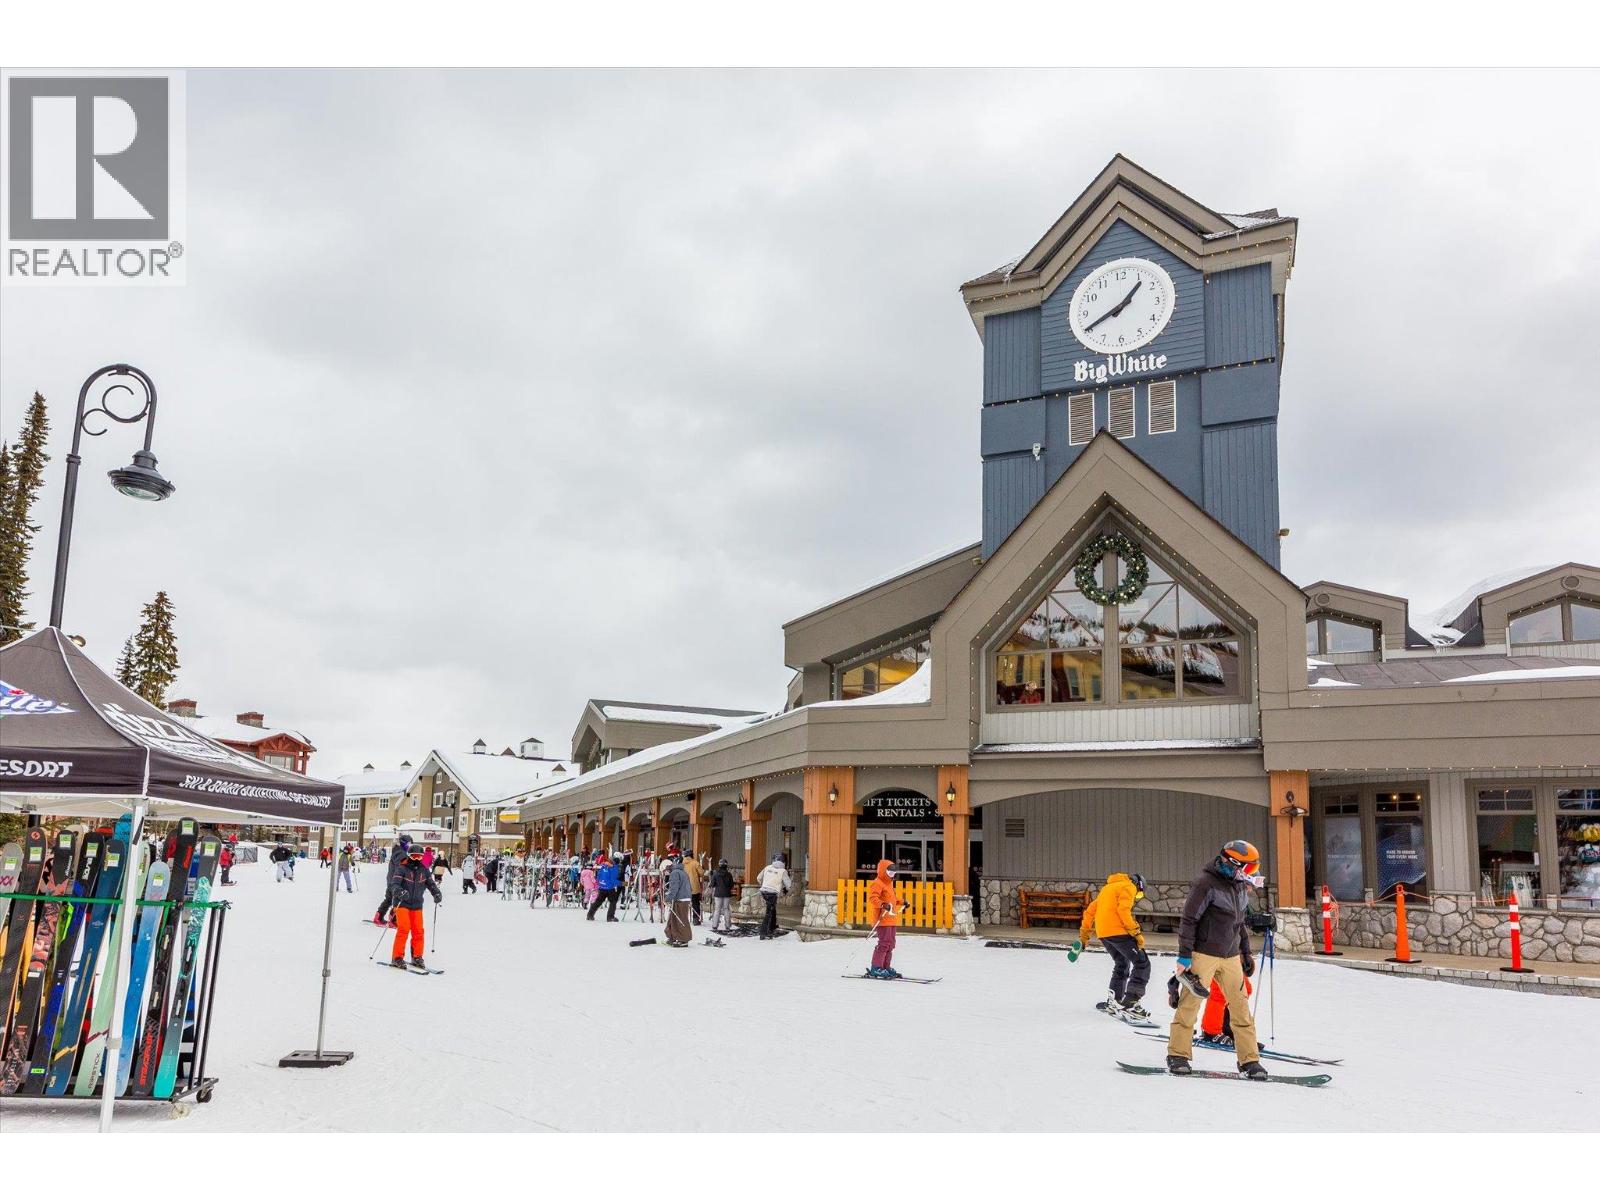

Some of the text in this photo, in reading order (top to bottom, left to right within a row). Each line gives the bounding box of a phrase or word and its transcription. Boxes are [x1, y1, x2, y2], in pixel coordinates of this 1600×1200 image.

[1115, 271, 1127, 281] 12
[1098, 279, 1108, 289] 11
[1149, 281, 1155, 291] 2
[1086, 293, 1097, 303] 10
[1154, 296, 1160, 306] 3
[1082, 310, 1089, 319] 9
[1149, 313, 1156, 322] 4
[1137, 327, 1143, 337] 5
[1101, 334, 1107, 343] 7
[1118, 334, 1125, 343] 6
[886, 797, 931, 807] TICKETS
[877, 808, 925, 818] RENTALS
